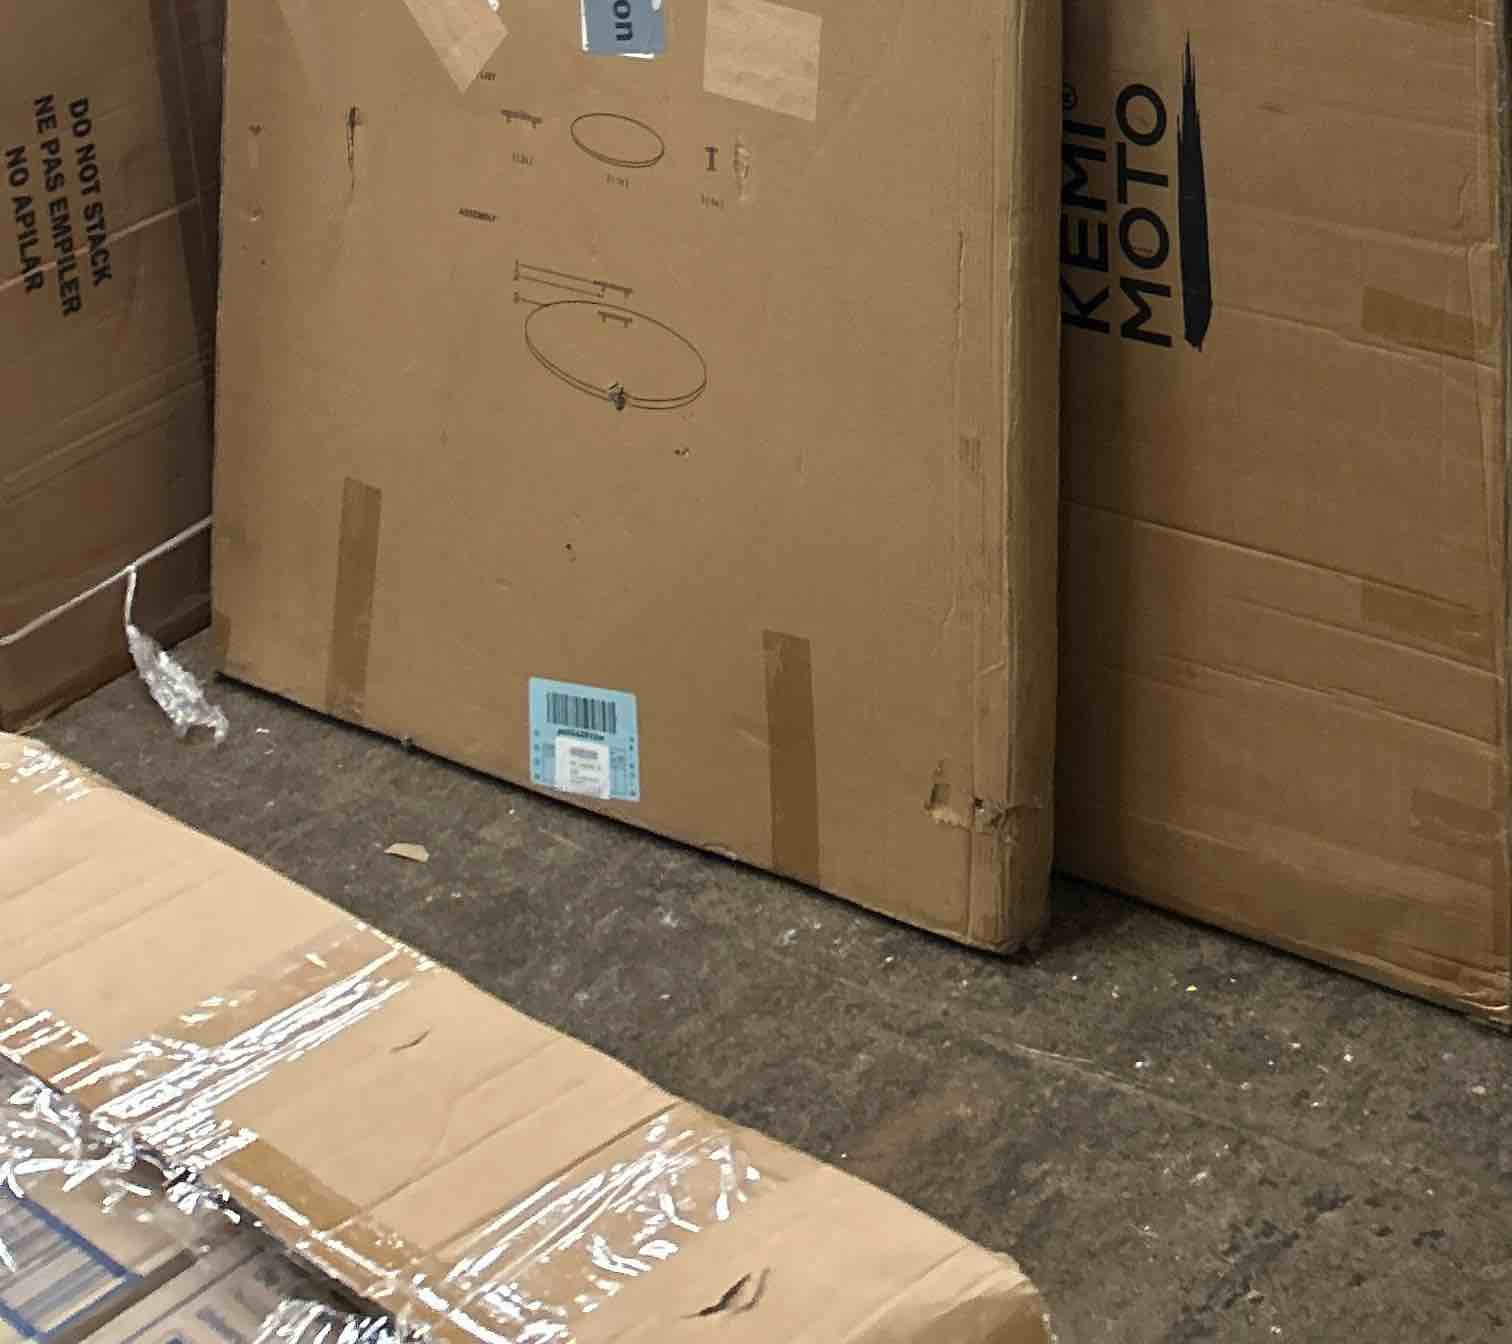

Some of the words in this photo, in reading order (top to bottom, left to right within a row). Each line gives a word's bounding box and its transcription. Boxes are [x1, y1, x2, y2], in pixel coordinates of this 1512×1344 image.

[33, 93, 58, 135] NE
[69, 96, 93, 138] DO
[5, 144, 30, 188] NO
[40, 137, 65, 193] PAS
[75, 143, 102, 196] NOT
[12, 195, 45, 294] APILAR
[82, 201, 113, 289] STACK
[1060, 121, 1111, 334] KEMI
[1115, 83, 1173, 349] MOTO
[48, 196, 83, 316] EMPILER
